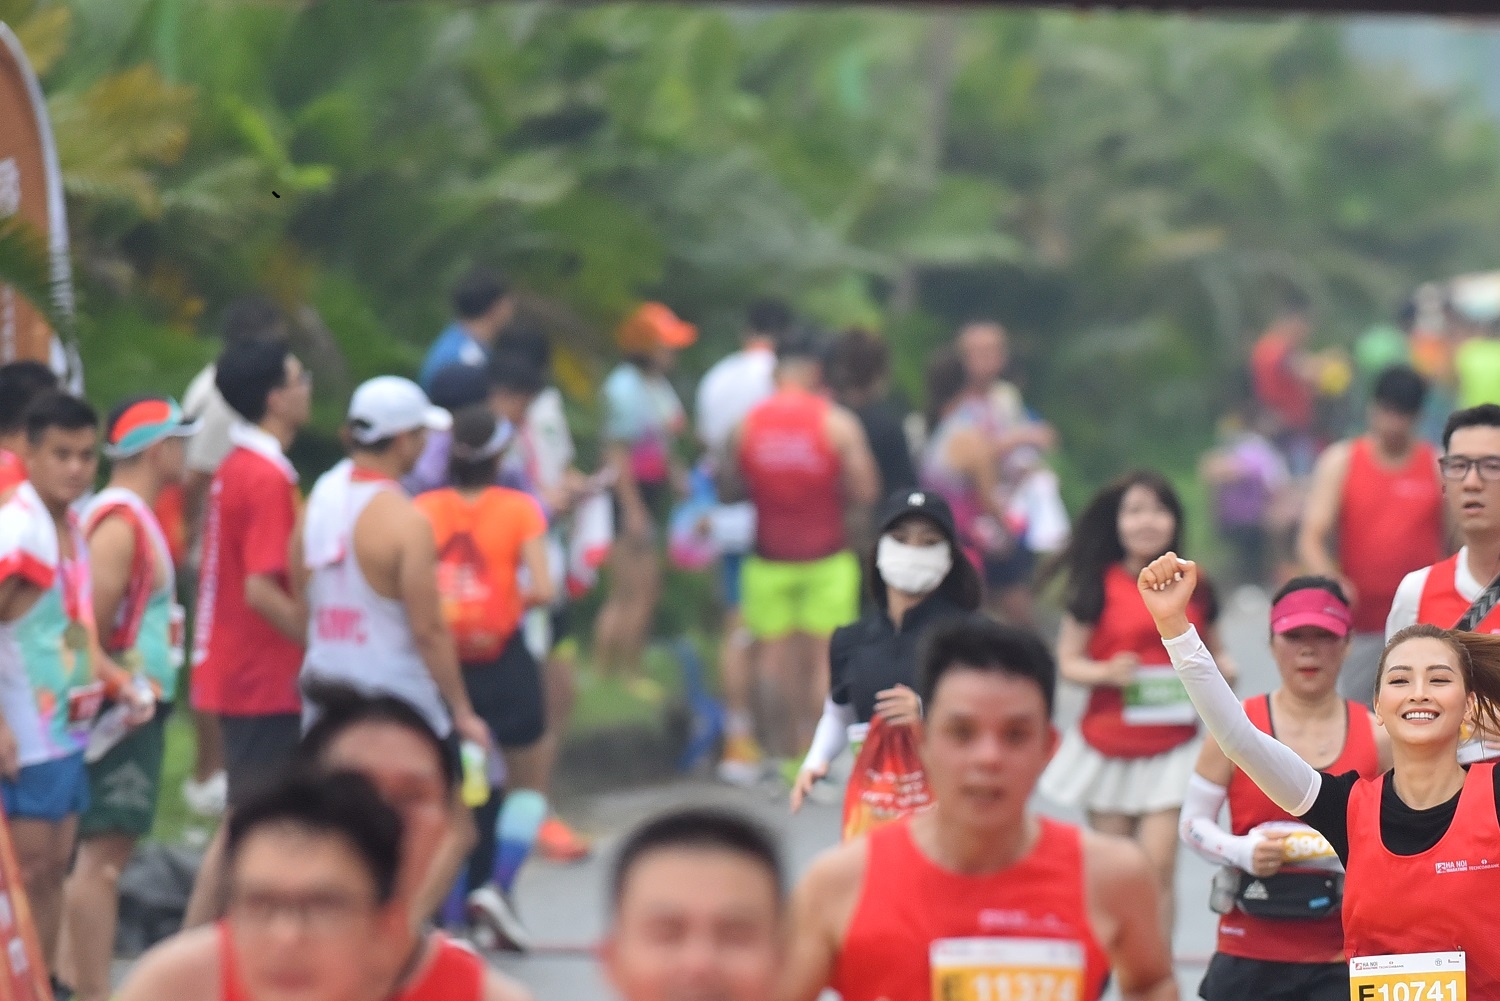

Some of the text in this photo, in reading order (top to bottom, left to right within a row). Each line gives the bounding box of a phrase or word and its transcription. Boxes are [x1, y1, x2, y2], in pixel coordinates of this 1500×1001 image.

[1284, 834, 1330, 858] 390
[1445, 859, 1468, 868] HA NOI
